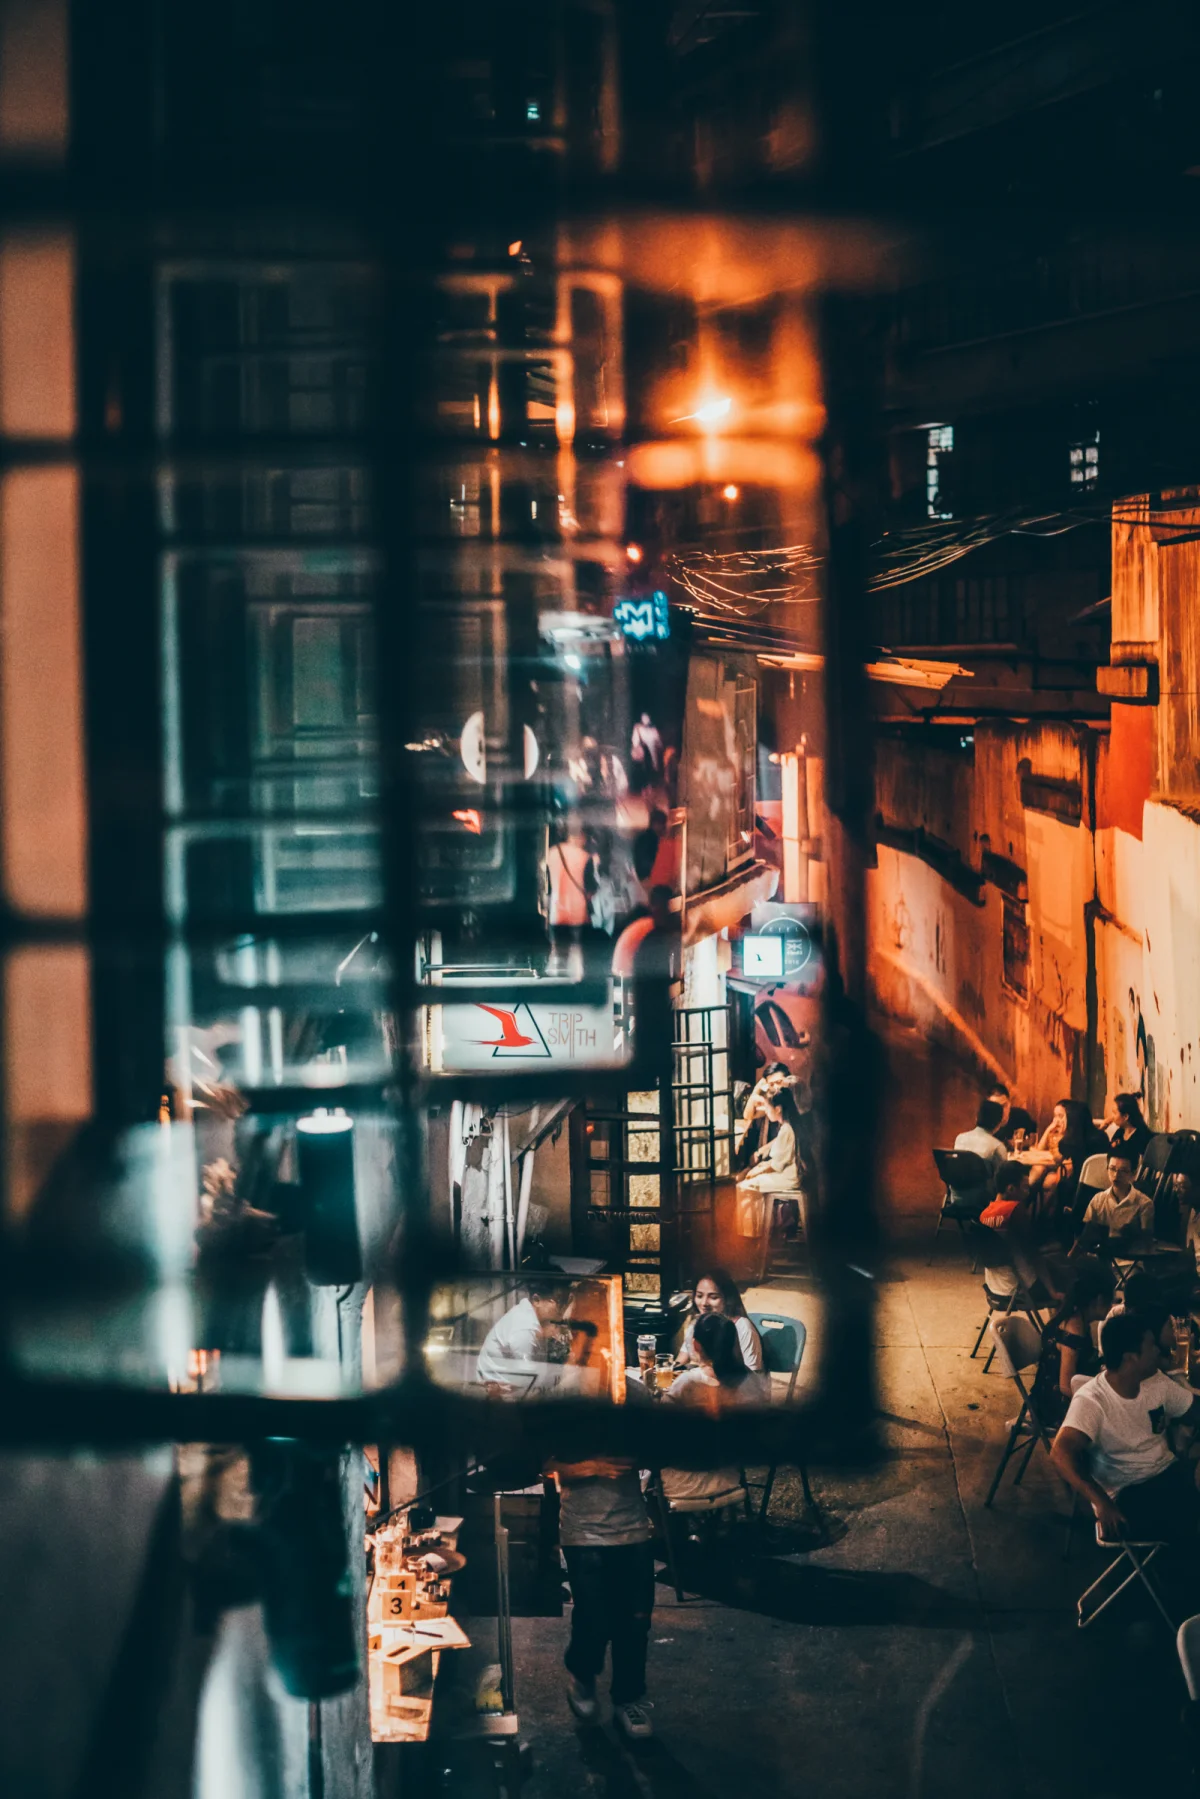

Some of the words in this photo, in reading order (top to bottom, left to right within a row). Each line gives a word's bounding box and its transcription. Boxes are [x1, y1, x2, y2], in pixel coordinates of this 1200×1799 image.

[548, 1012, 583, 1029] TRIP
[547, 1027, 597, 1057] SMITH
[390, 1597, 402, 1614] 3
